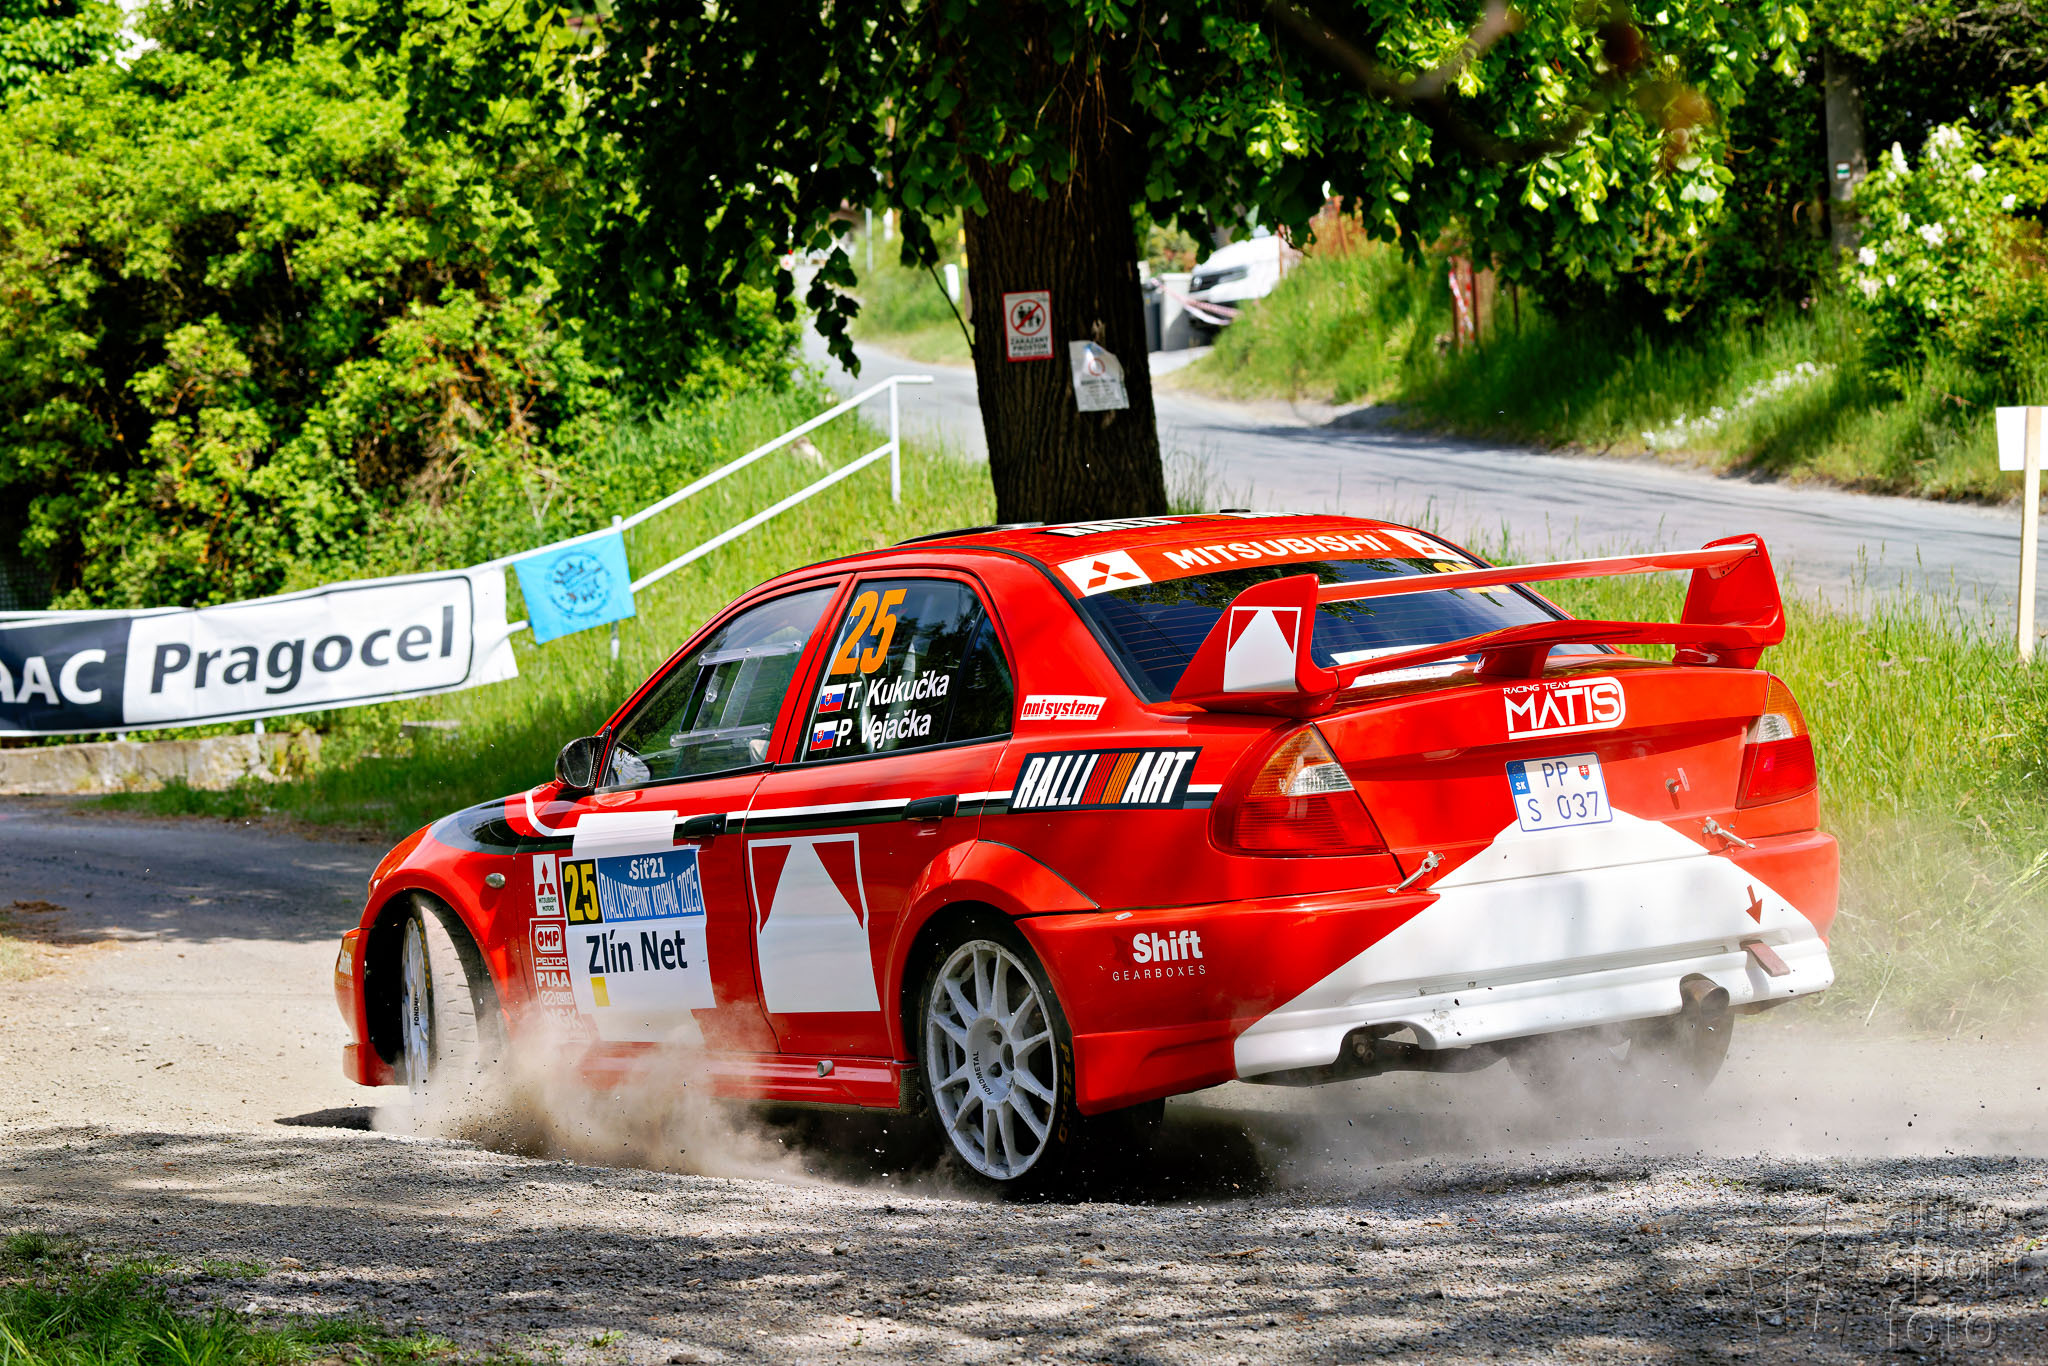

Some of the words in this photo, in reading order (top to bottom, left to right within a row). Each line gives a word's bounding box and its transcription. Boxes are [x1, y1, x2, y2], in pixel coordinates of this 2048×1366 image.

[1163, 534, 1393, 570] MITSUBISHI
[830, 588, 907, 676] 25
[150, 605, 455, 695] Pragocel
[847, 681, 862, 710] T.
[866, 670, 950, 707] Kukučka
[1503, 684, 1539, 695] RACING
[1543, 681, 1570, 691] TEAM
[1504, 684, 1621, 732] MATIS
[836, 718, 853, 747] P.
[861, 709, 932, 749] Vejačka
[1012, 753, 1100, 809] RALLI
[1120, 751, 1197, 804] ART
[1515, 781, 1527, 791] SK
[1541, 761, 1568, 788] PP
[1527, 798, 1542, 822] S
[1557, 791, 1598, 819] 037
[630, 857, 666, 880] Síť21
[538, 896, 557, 904] MITSUBISHI
[564, 863, 599, 922] 25
[600, 872, 653, 919] RALLYSPRINT
[651, 872, 680, 915] KOPNÁ
[677, 863, 702, 913] 2025
[537, 930, 560, 947] OMP
[586, 929, 634, 975] Zlín
[640, 930, 688, 972] Net
[1132, 930, 1204, 963] Shift
[536, 956, 567, 966] PELTOR
[1112, 965, 1206, 981] GEARBOXES
[537, 971, 571, 988] PIAA
[972, 1050, 993, 1096] FONDMETAL
